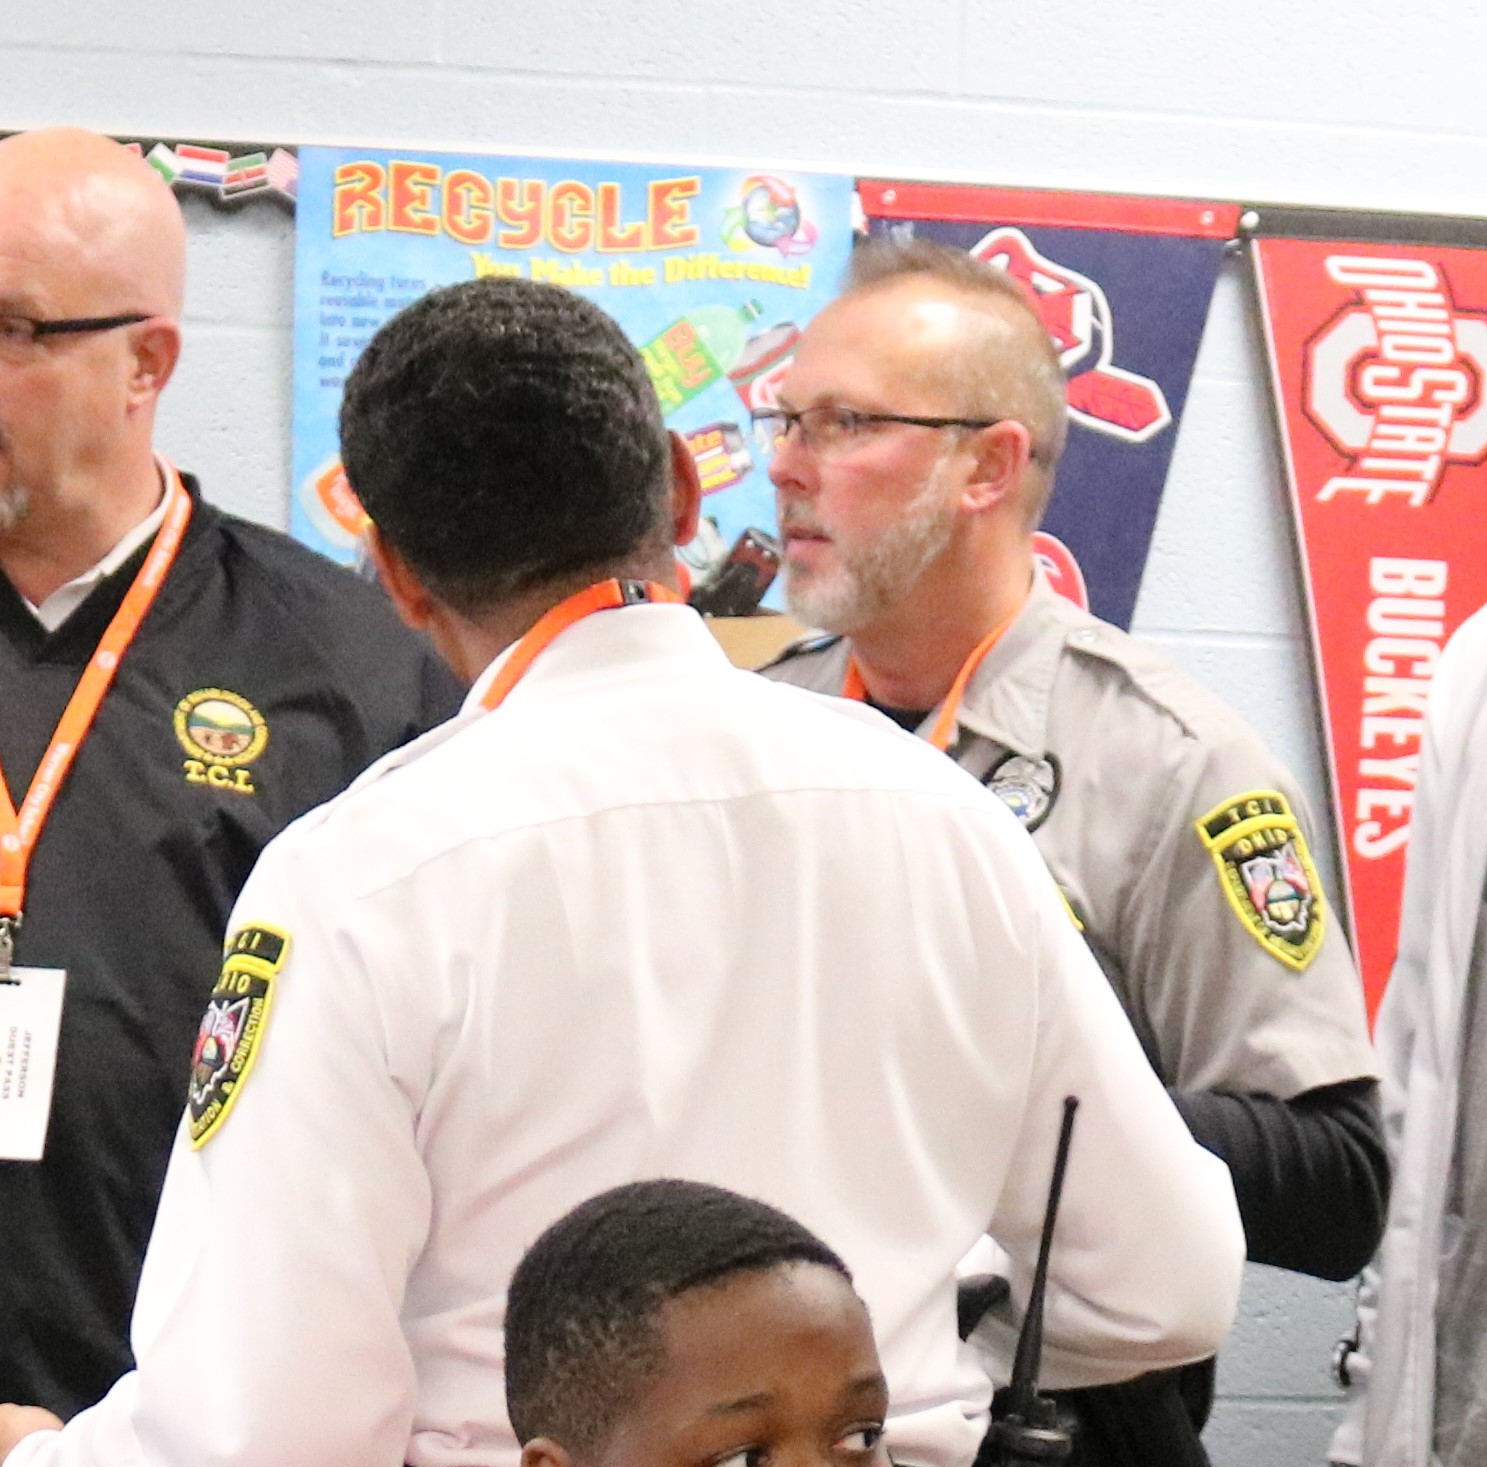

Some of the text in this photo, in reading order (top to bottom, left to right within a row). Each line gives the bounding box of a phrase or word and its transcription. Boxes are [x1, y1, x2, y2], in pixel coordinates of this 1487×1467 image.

[333, 160, 702, 253] RECYCLE
[471, 252, 810, 289] You Make the Difference!
[1316, 254, 1470, 507] OHIO STATE
[1353, 556, 1449, 862] BUCKEYES
[1233, 828, 1289, 856] OHIO
[16, 1029, 33, 1100] JEFFERSON
